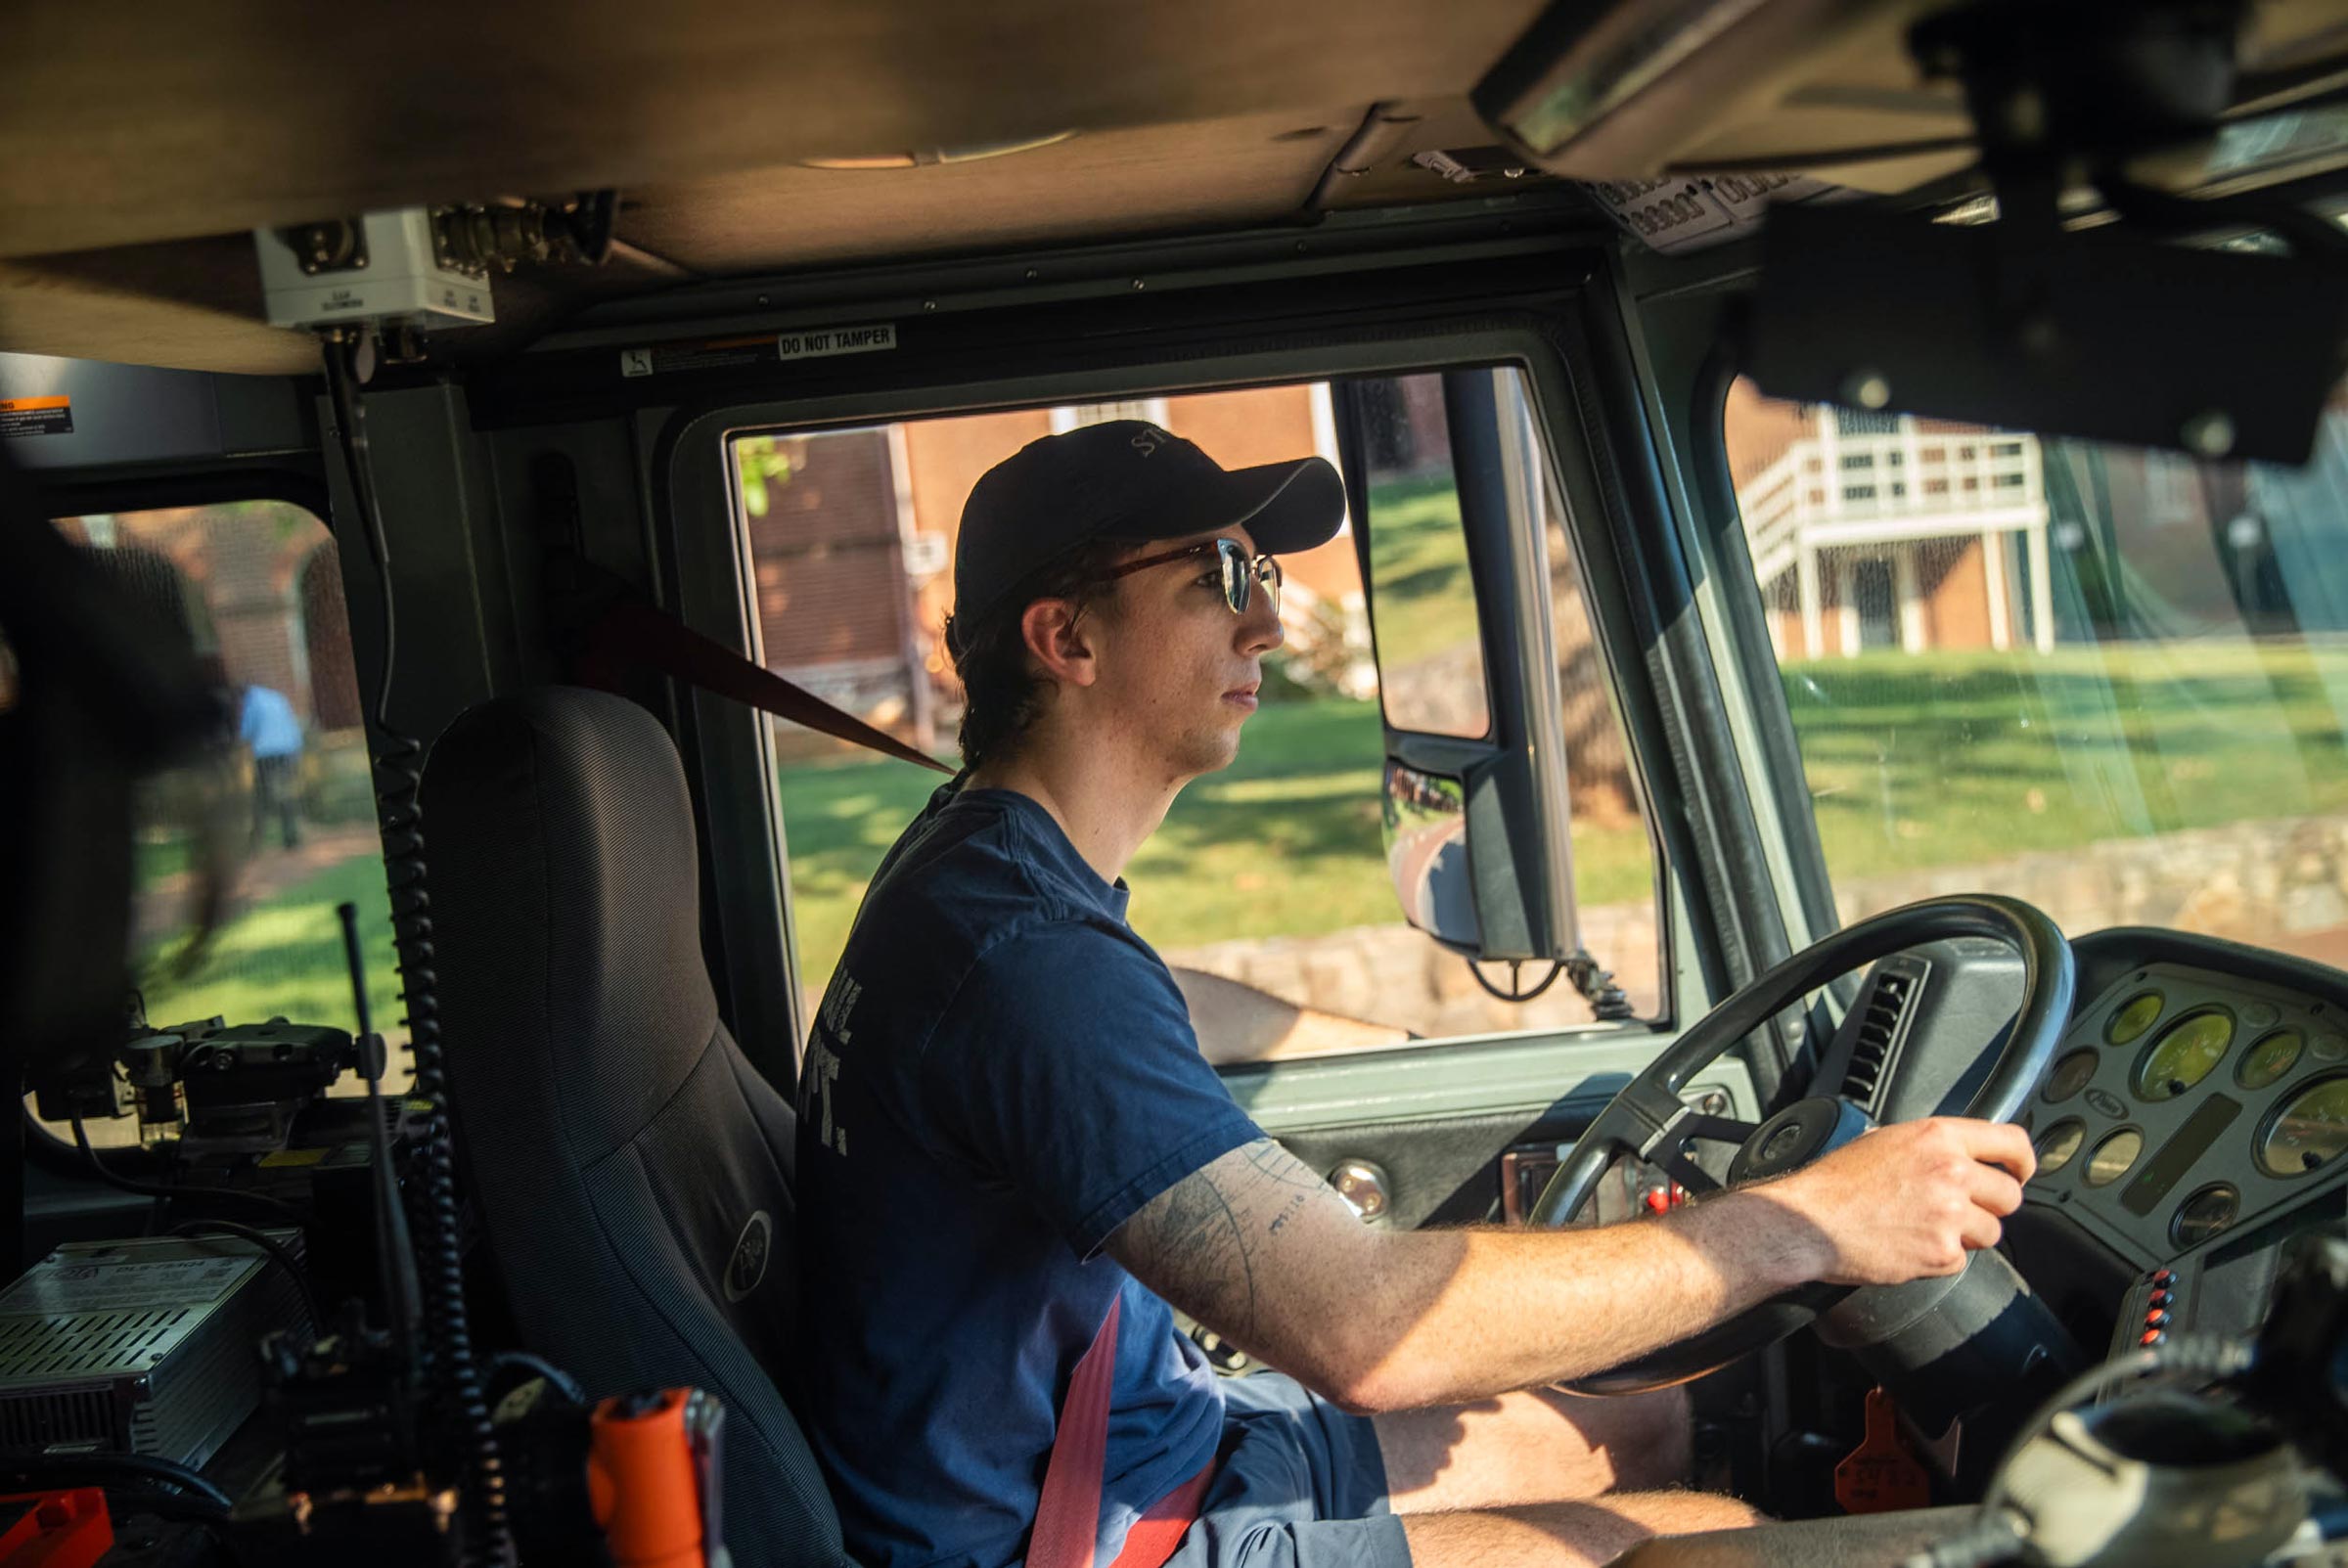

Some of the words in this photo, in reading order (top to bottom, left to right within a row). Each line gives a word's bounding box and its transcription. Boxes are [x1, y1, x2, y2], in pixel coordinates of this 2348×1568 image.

[782, 337, 801, 354] DO
[805, 334, 831, 351] NOT
[835, 328, 890, 348] TAMPER
